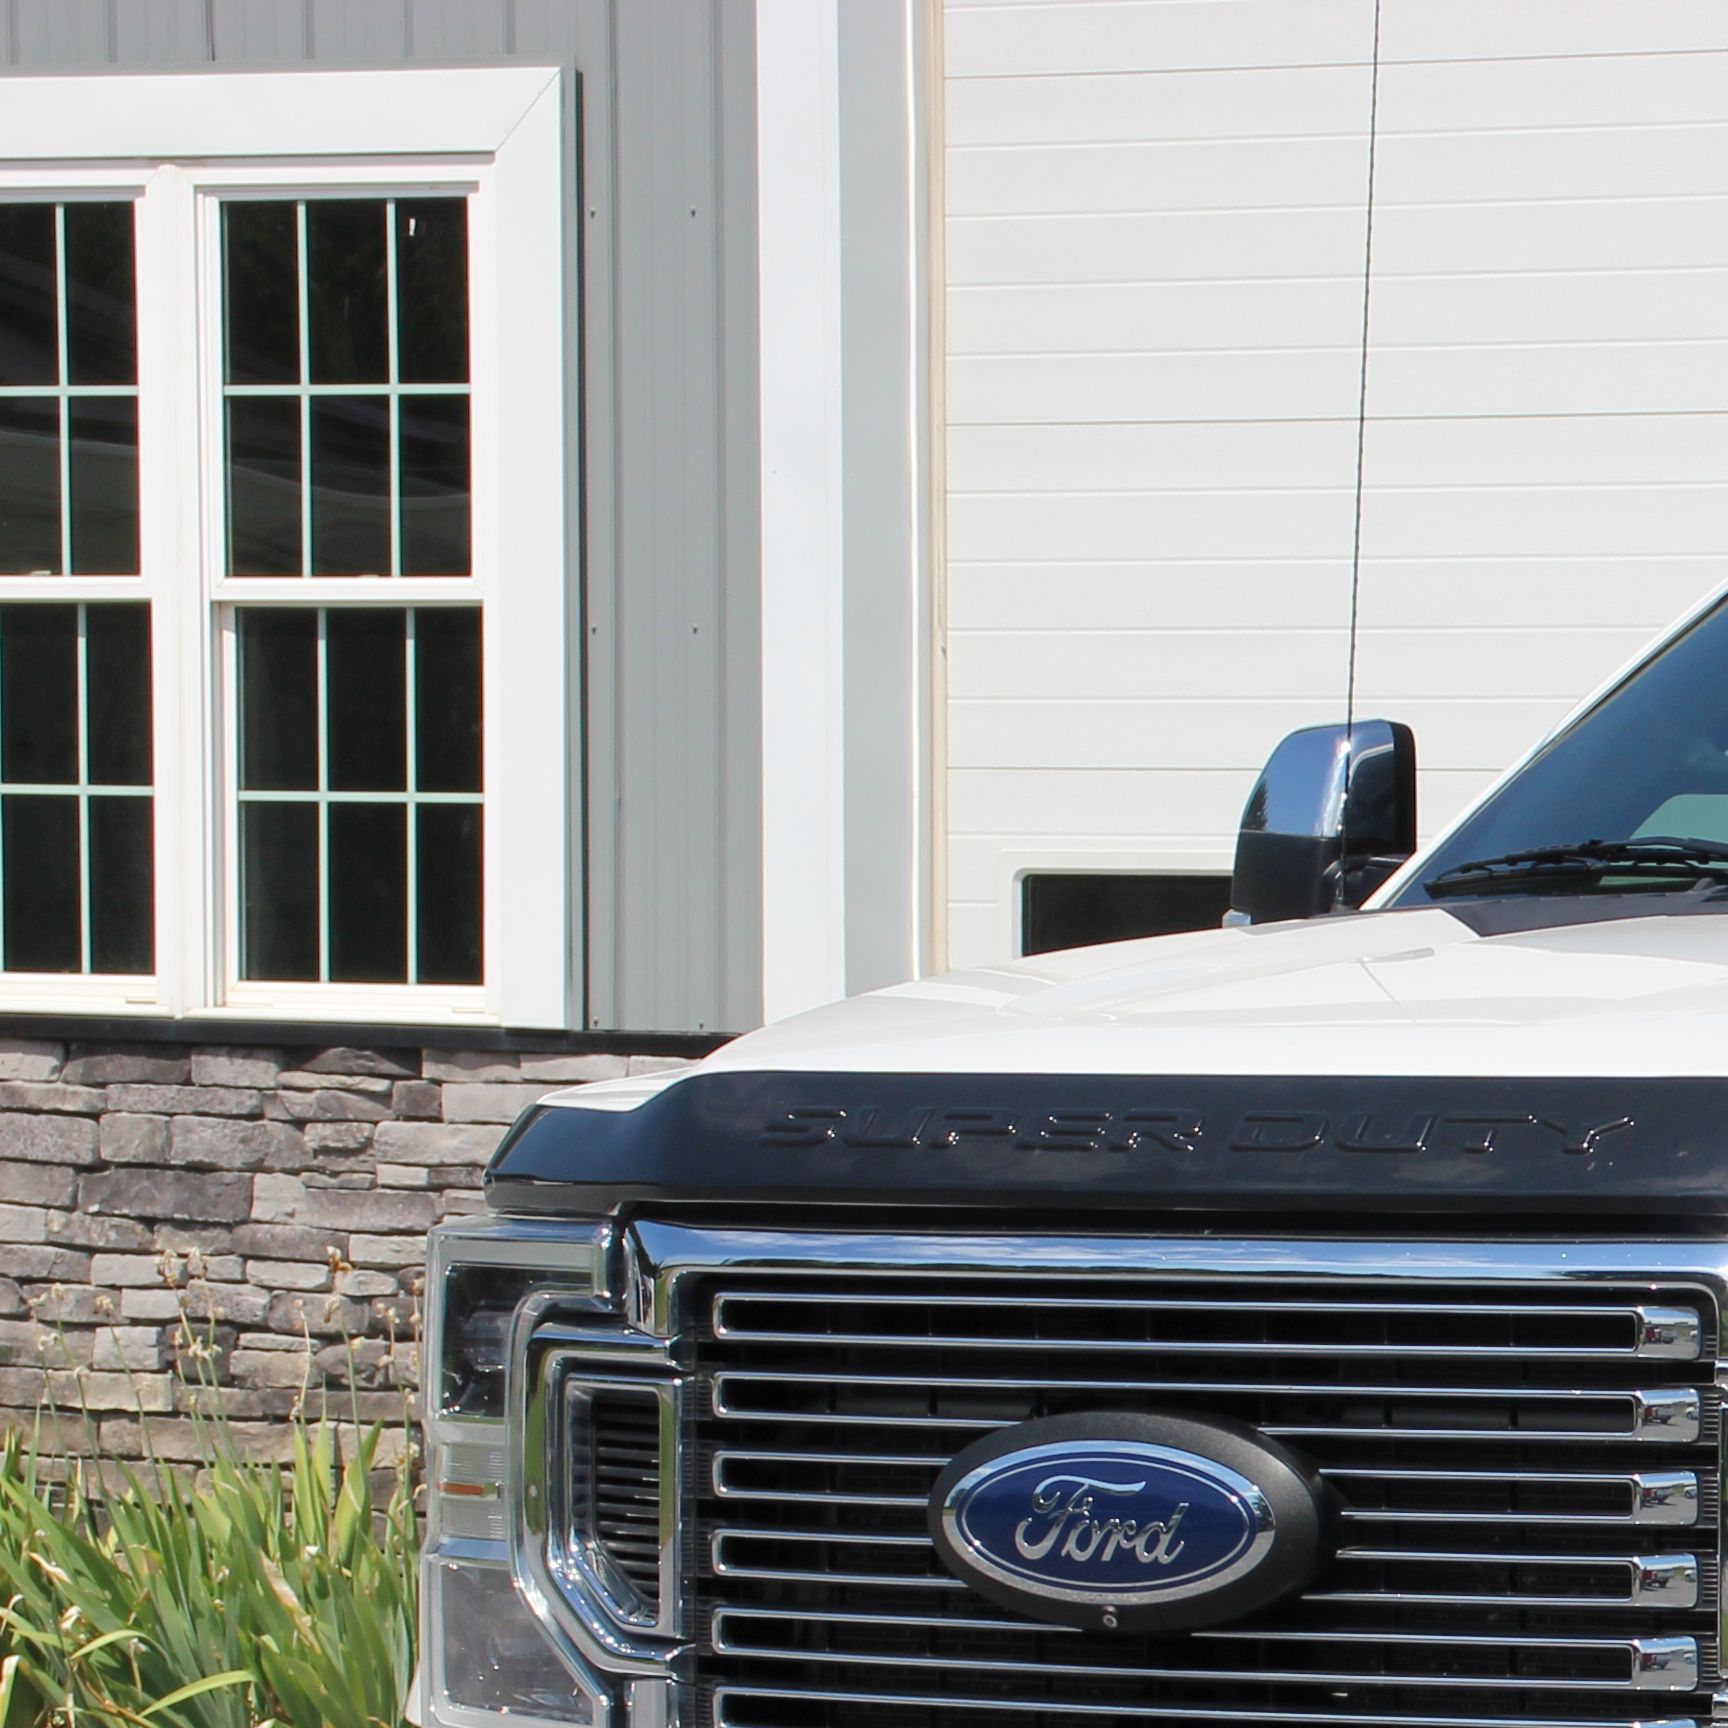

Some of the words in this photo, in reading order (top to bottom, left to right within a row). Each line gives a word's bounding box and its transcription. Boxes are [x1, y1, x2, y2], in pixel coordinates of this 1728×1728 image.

[757, 1105, 1204, 1153] SUPER
[1229, 1108, 1635, 1155] DUTY
[1015, 1475, 1189, 1565] Ford
